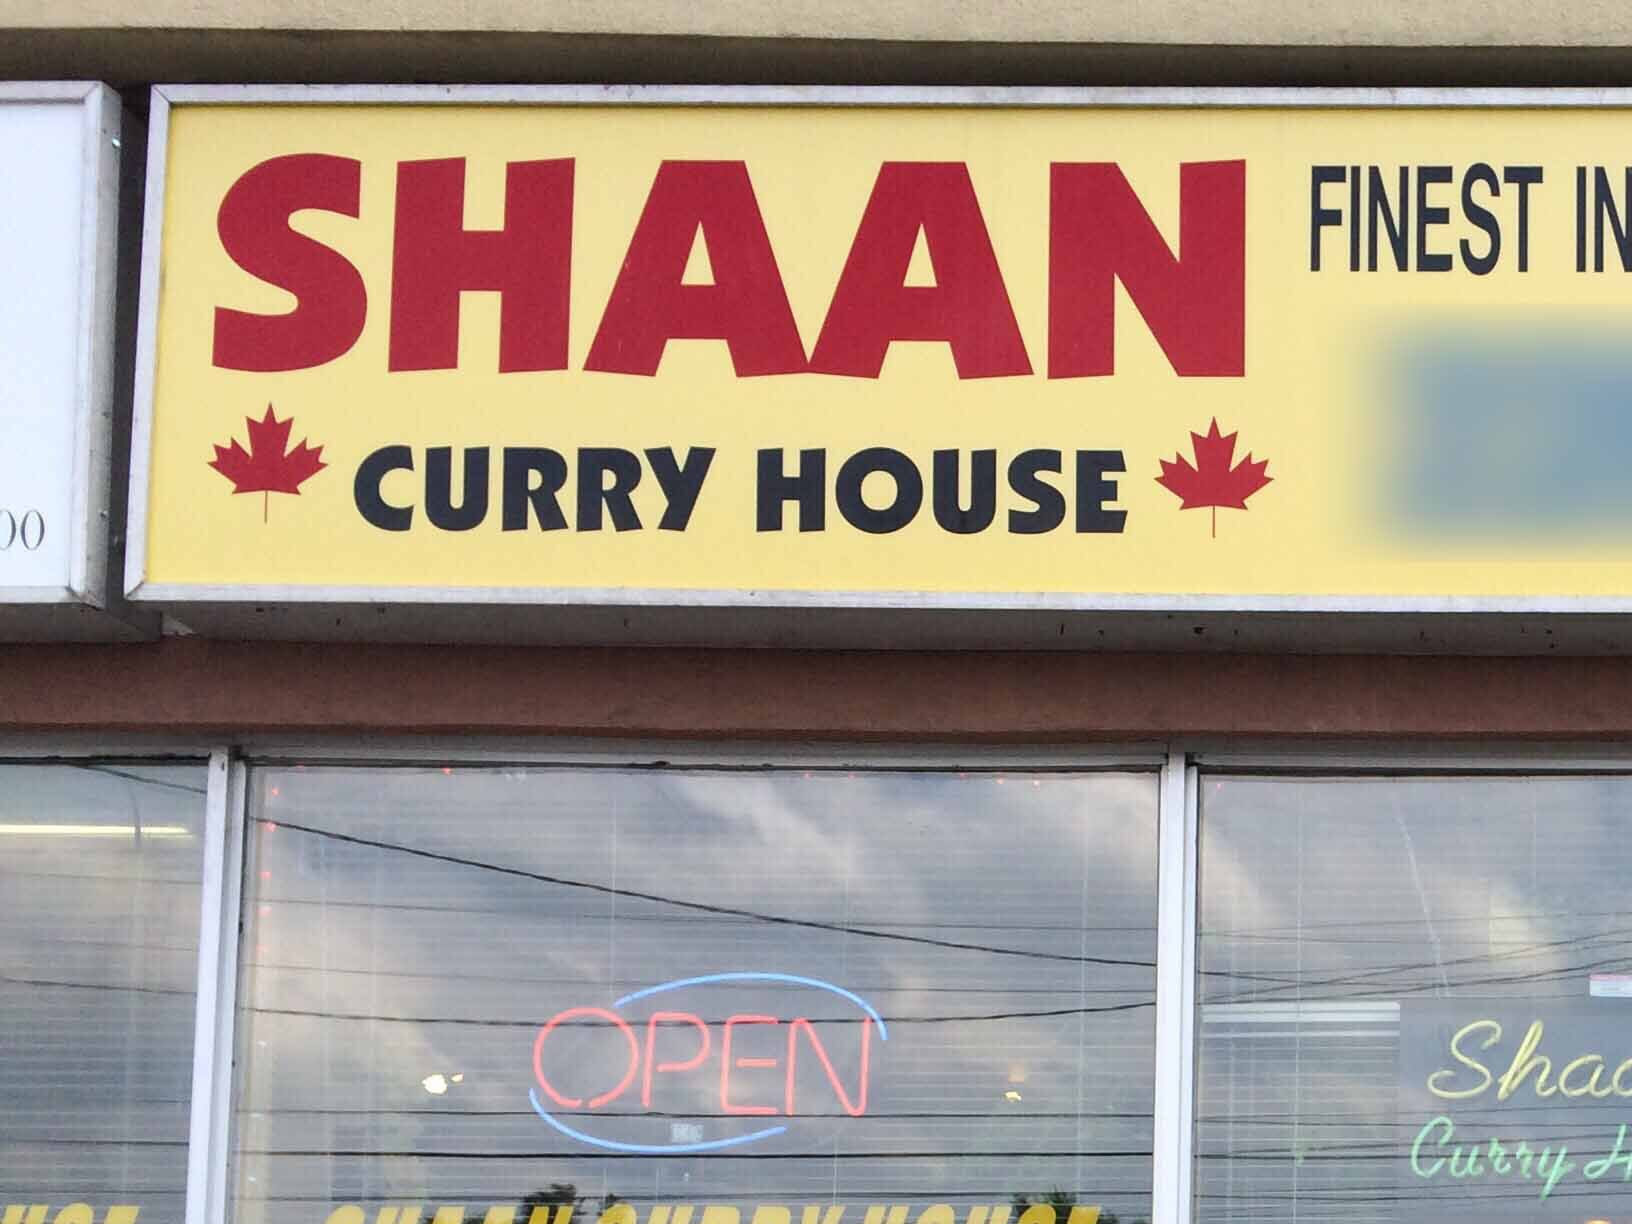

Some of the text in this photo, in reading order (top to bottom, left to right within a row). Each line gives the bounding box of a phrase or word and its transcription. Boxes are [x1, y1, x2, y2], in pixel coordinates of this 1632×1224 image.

[212, 153, 1246, 379] SHAAN
[1310, 163, 1544, 275] FINEST
[353, 445, 1128, 535] CURRY HOUSE
[533, 1007, 872, 1117] OPEN
[1410, 1116, 1576, 1200] Curry
